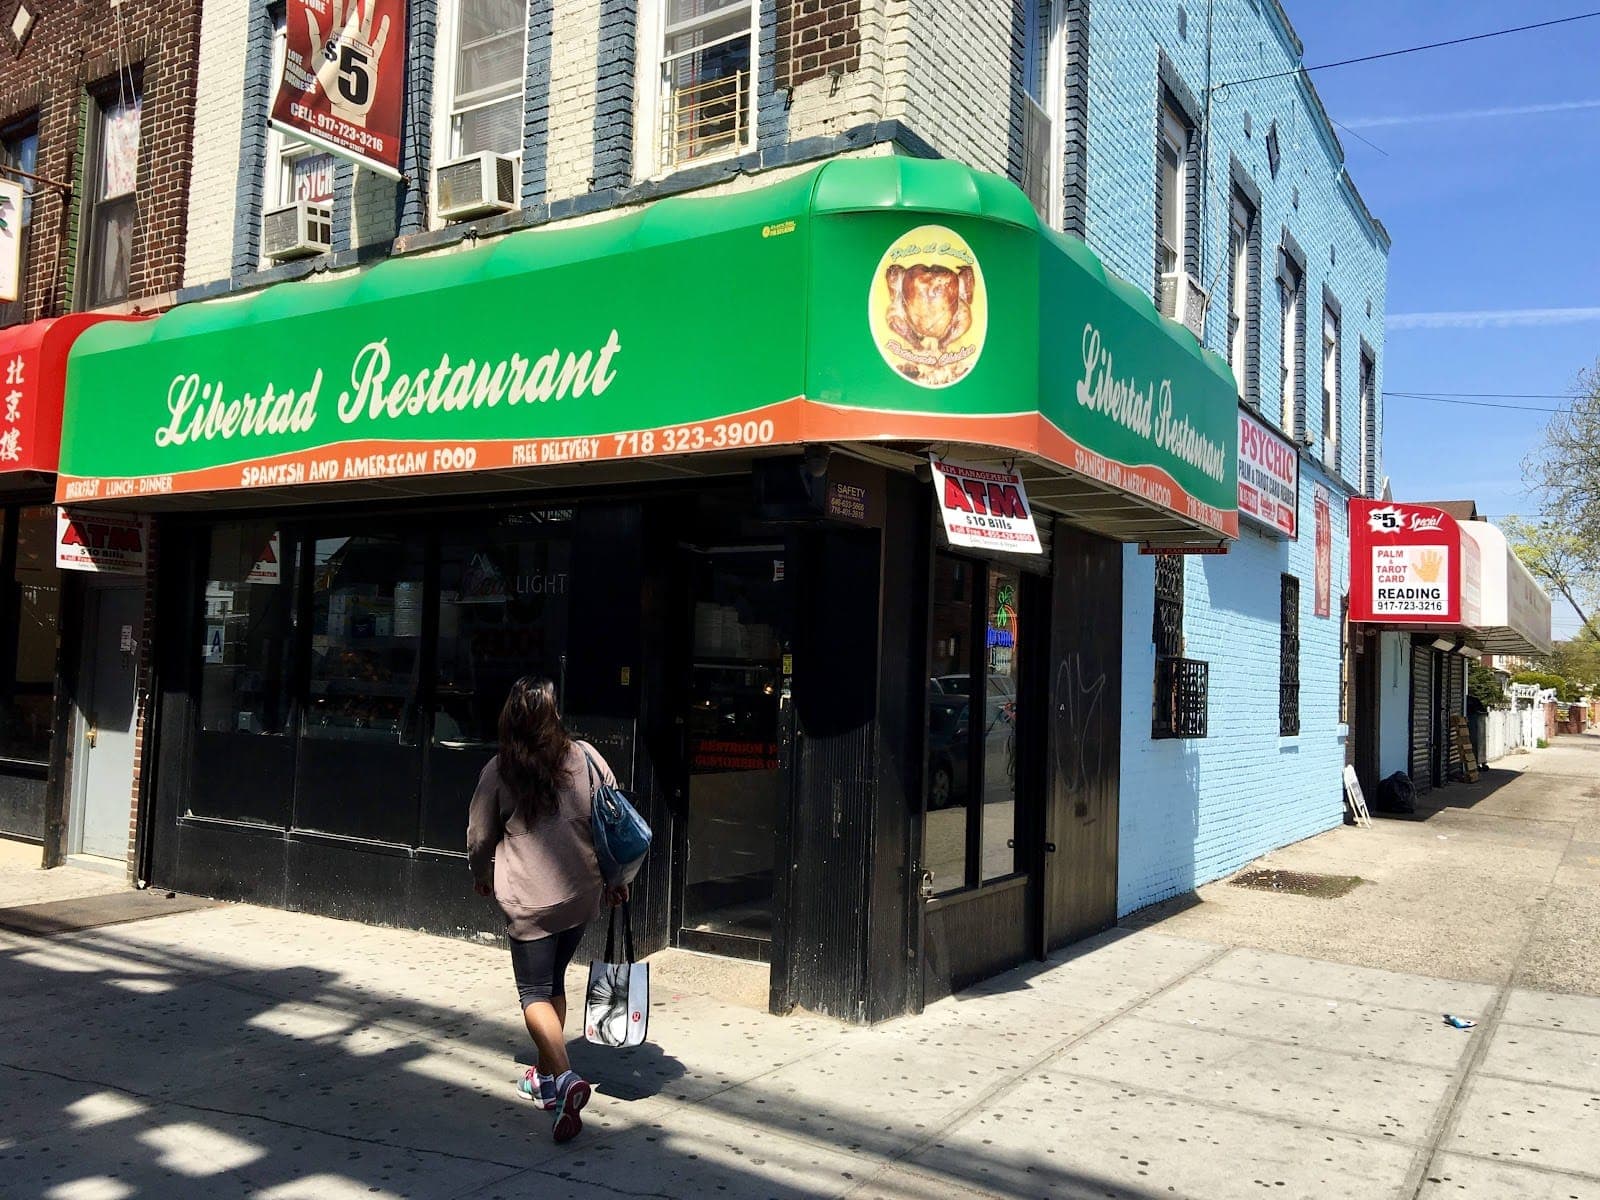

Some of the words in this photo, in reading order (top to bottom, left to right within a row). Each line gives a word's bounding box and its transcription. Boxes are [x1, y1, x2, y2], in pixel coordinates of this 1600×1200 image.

[290, 102, 317, 125] CELL:
[155, 367, 323, 447] Libertad
[337, 328, 622, 424] Restaurant
[1076, 323, 1153, 440] Libertad
[1155, 379, 1225, 483] Restaurant
[613, 432, 655, 456] 718
[661, 418, 774, 453] 323-3900
[512, 443, 537, 465] FREE
[541, 438, 600, 464] DELIVERY
[1240, 419, 1294, 485] PSYCHIC
[241, 464, 304, 487] SPANISH
[309, 458, 338, 482] AND
[343, 451, 427, 479] AMERICAN
[433, 447, 477, 471] FOOD
[1074, 448, 1106, 479] SPANISH
[1107, 463, 1121, 488] AND
[1122, 470, 1154, 503] AMERICAN
[837, 483, 866, 498] SAFETY
[944, 474, 1029, 520] ATM
[61, 520, 143, 553] ATM
[987, 518, 1012, 530] Bills
[1377, 550, 1404, 558] PALM
[1376, 565, 1408, 574] TAROT
[1378, 575, 1405, 583] CARD
[516, 572, 569, 594] LIGHT
[1378, 588, 1441, 600] READING
[1377, 601, 1443, 611] 917-723-3216
